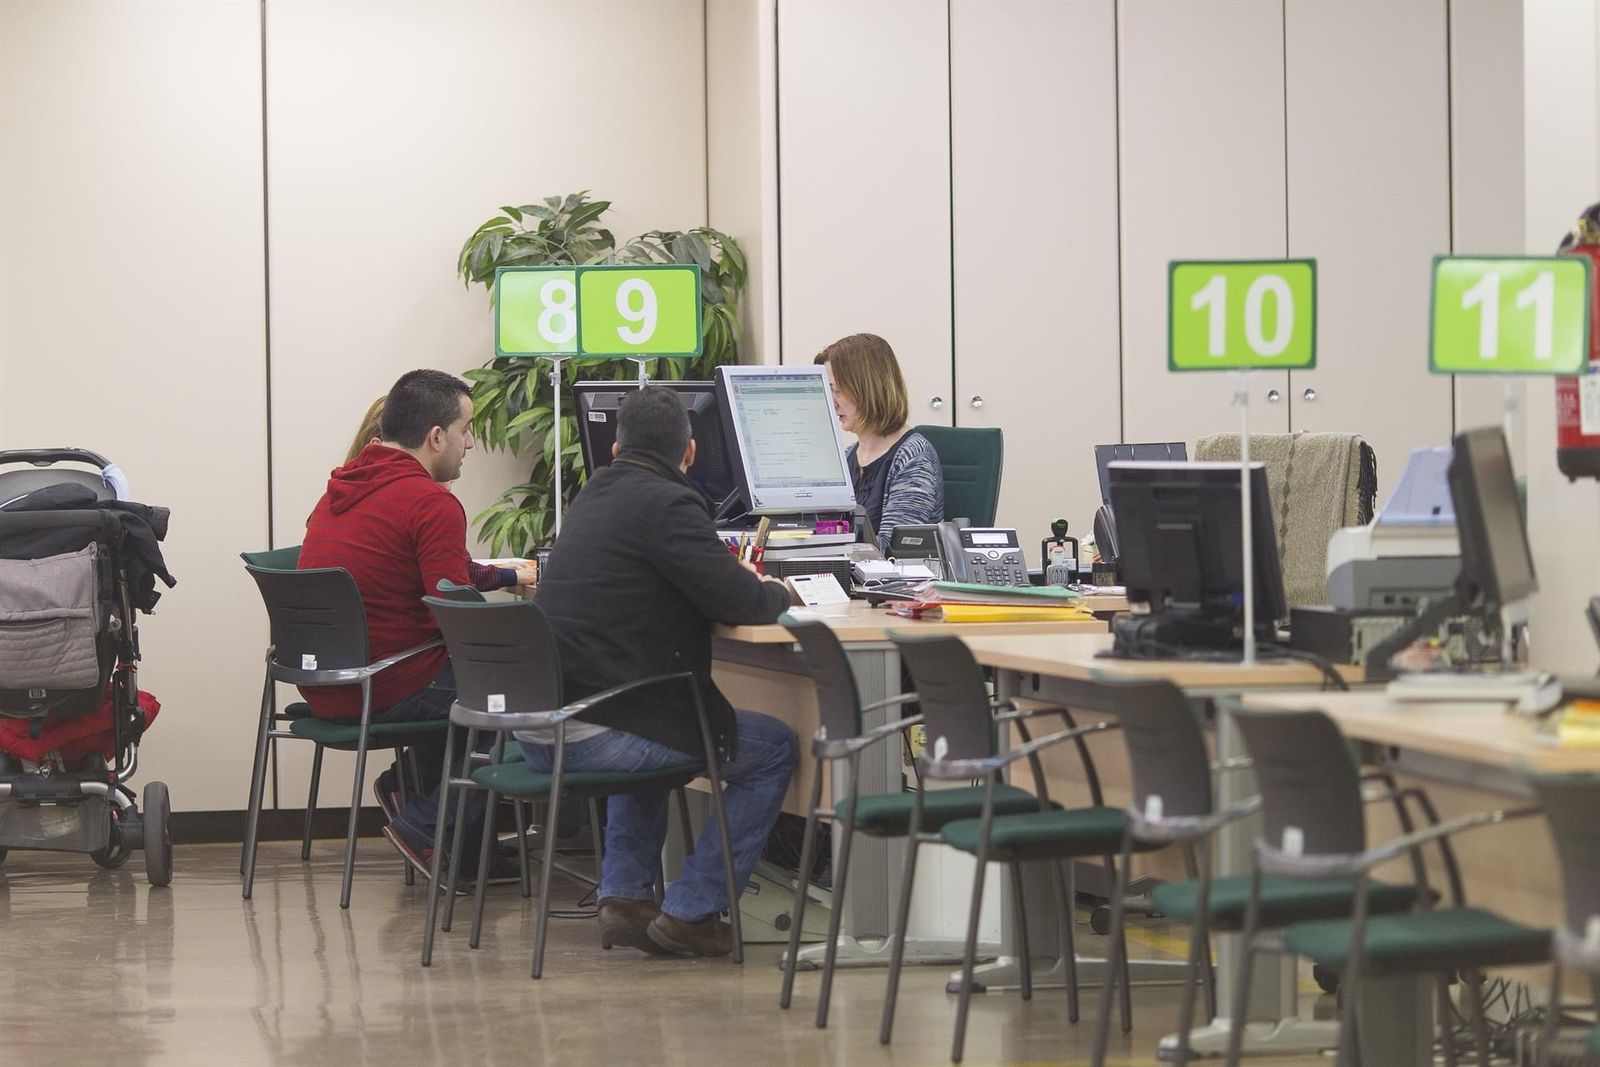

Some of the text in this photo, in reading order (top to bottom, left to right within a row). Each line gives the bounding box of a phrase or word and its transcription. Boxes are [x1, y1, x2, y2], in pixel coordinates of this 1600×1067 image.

[538, 279, 576, 344] 8
[615, 278, 658, 345] 9
[1191, 275, 1294, 357] 10
[1461, 270, 1555, 360] 11
